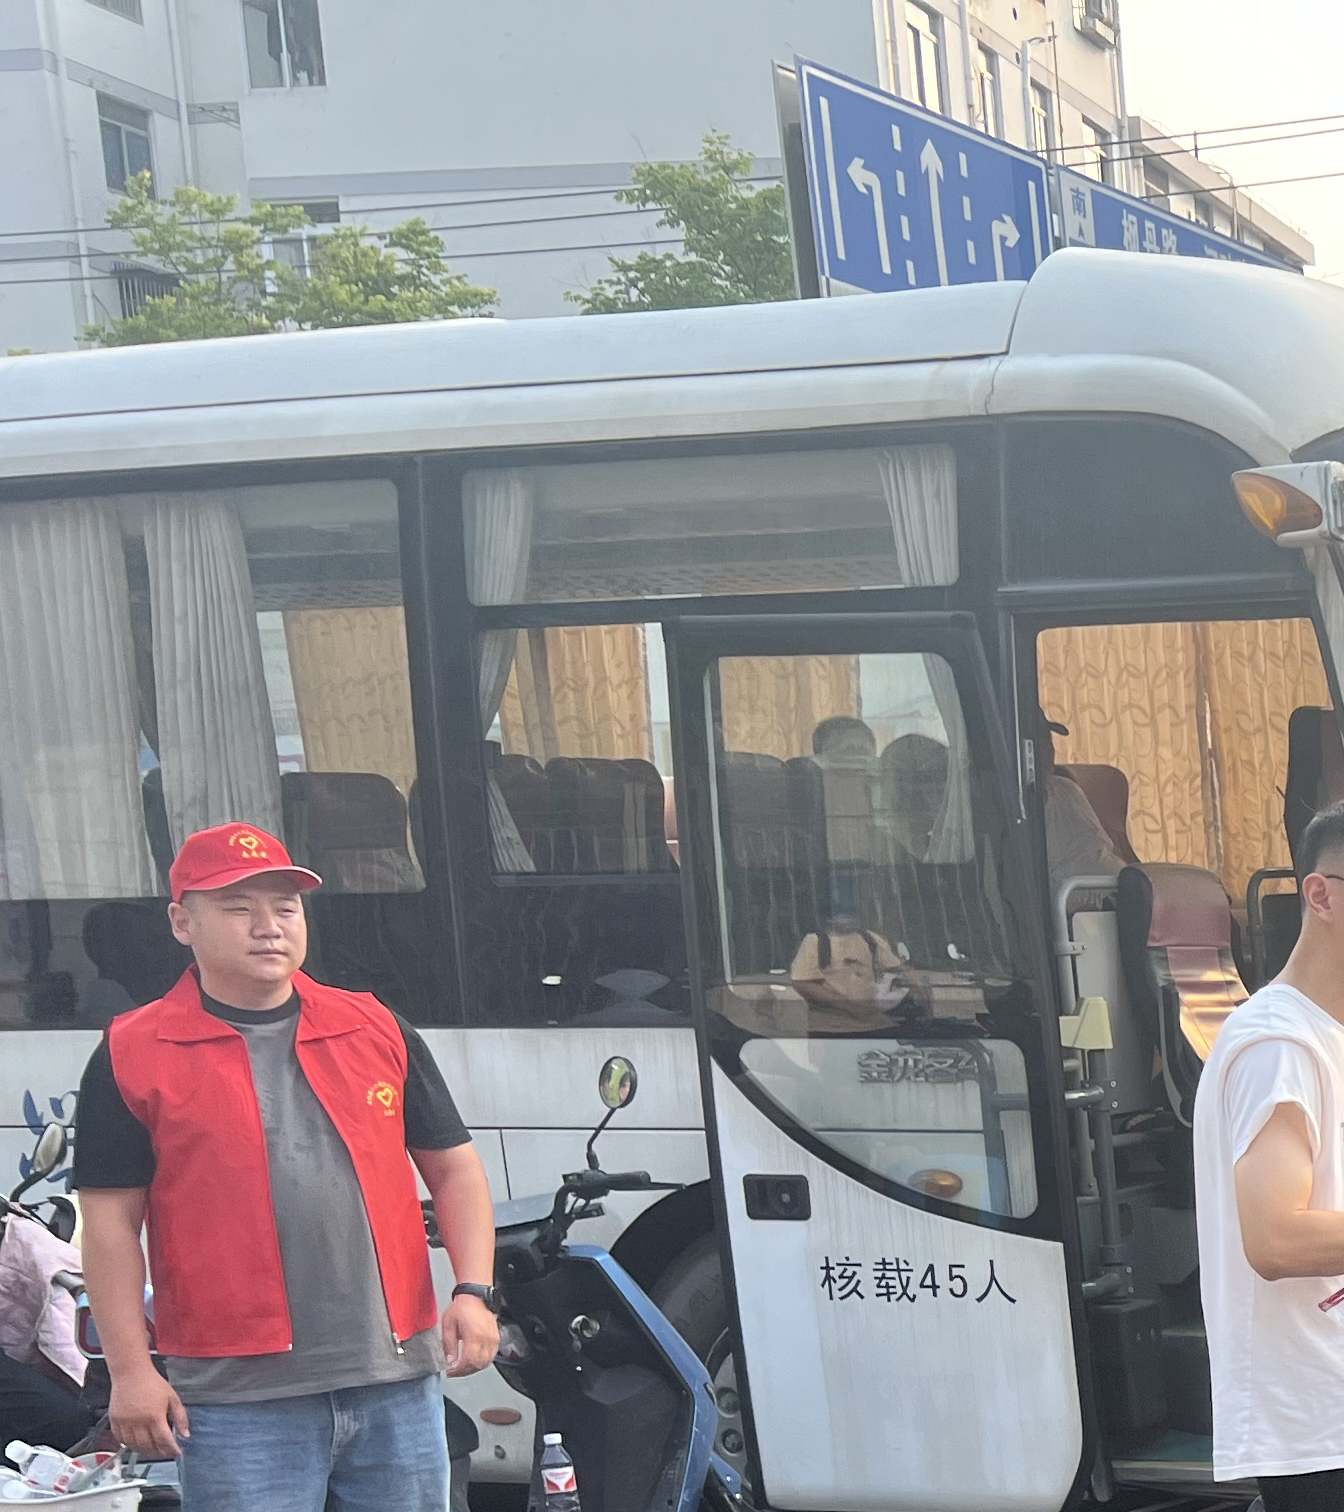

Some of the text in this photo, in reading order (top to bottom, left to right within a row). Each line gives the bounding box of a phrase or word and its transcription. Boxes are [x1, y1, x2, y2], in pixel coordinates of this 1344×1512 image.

[1070, 187, 1087, 219] 南
[820, 1255, 1017, 1304] 核载45人
